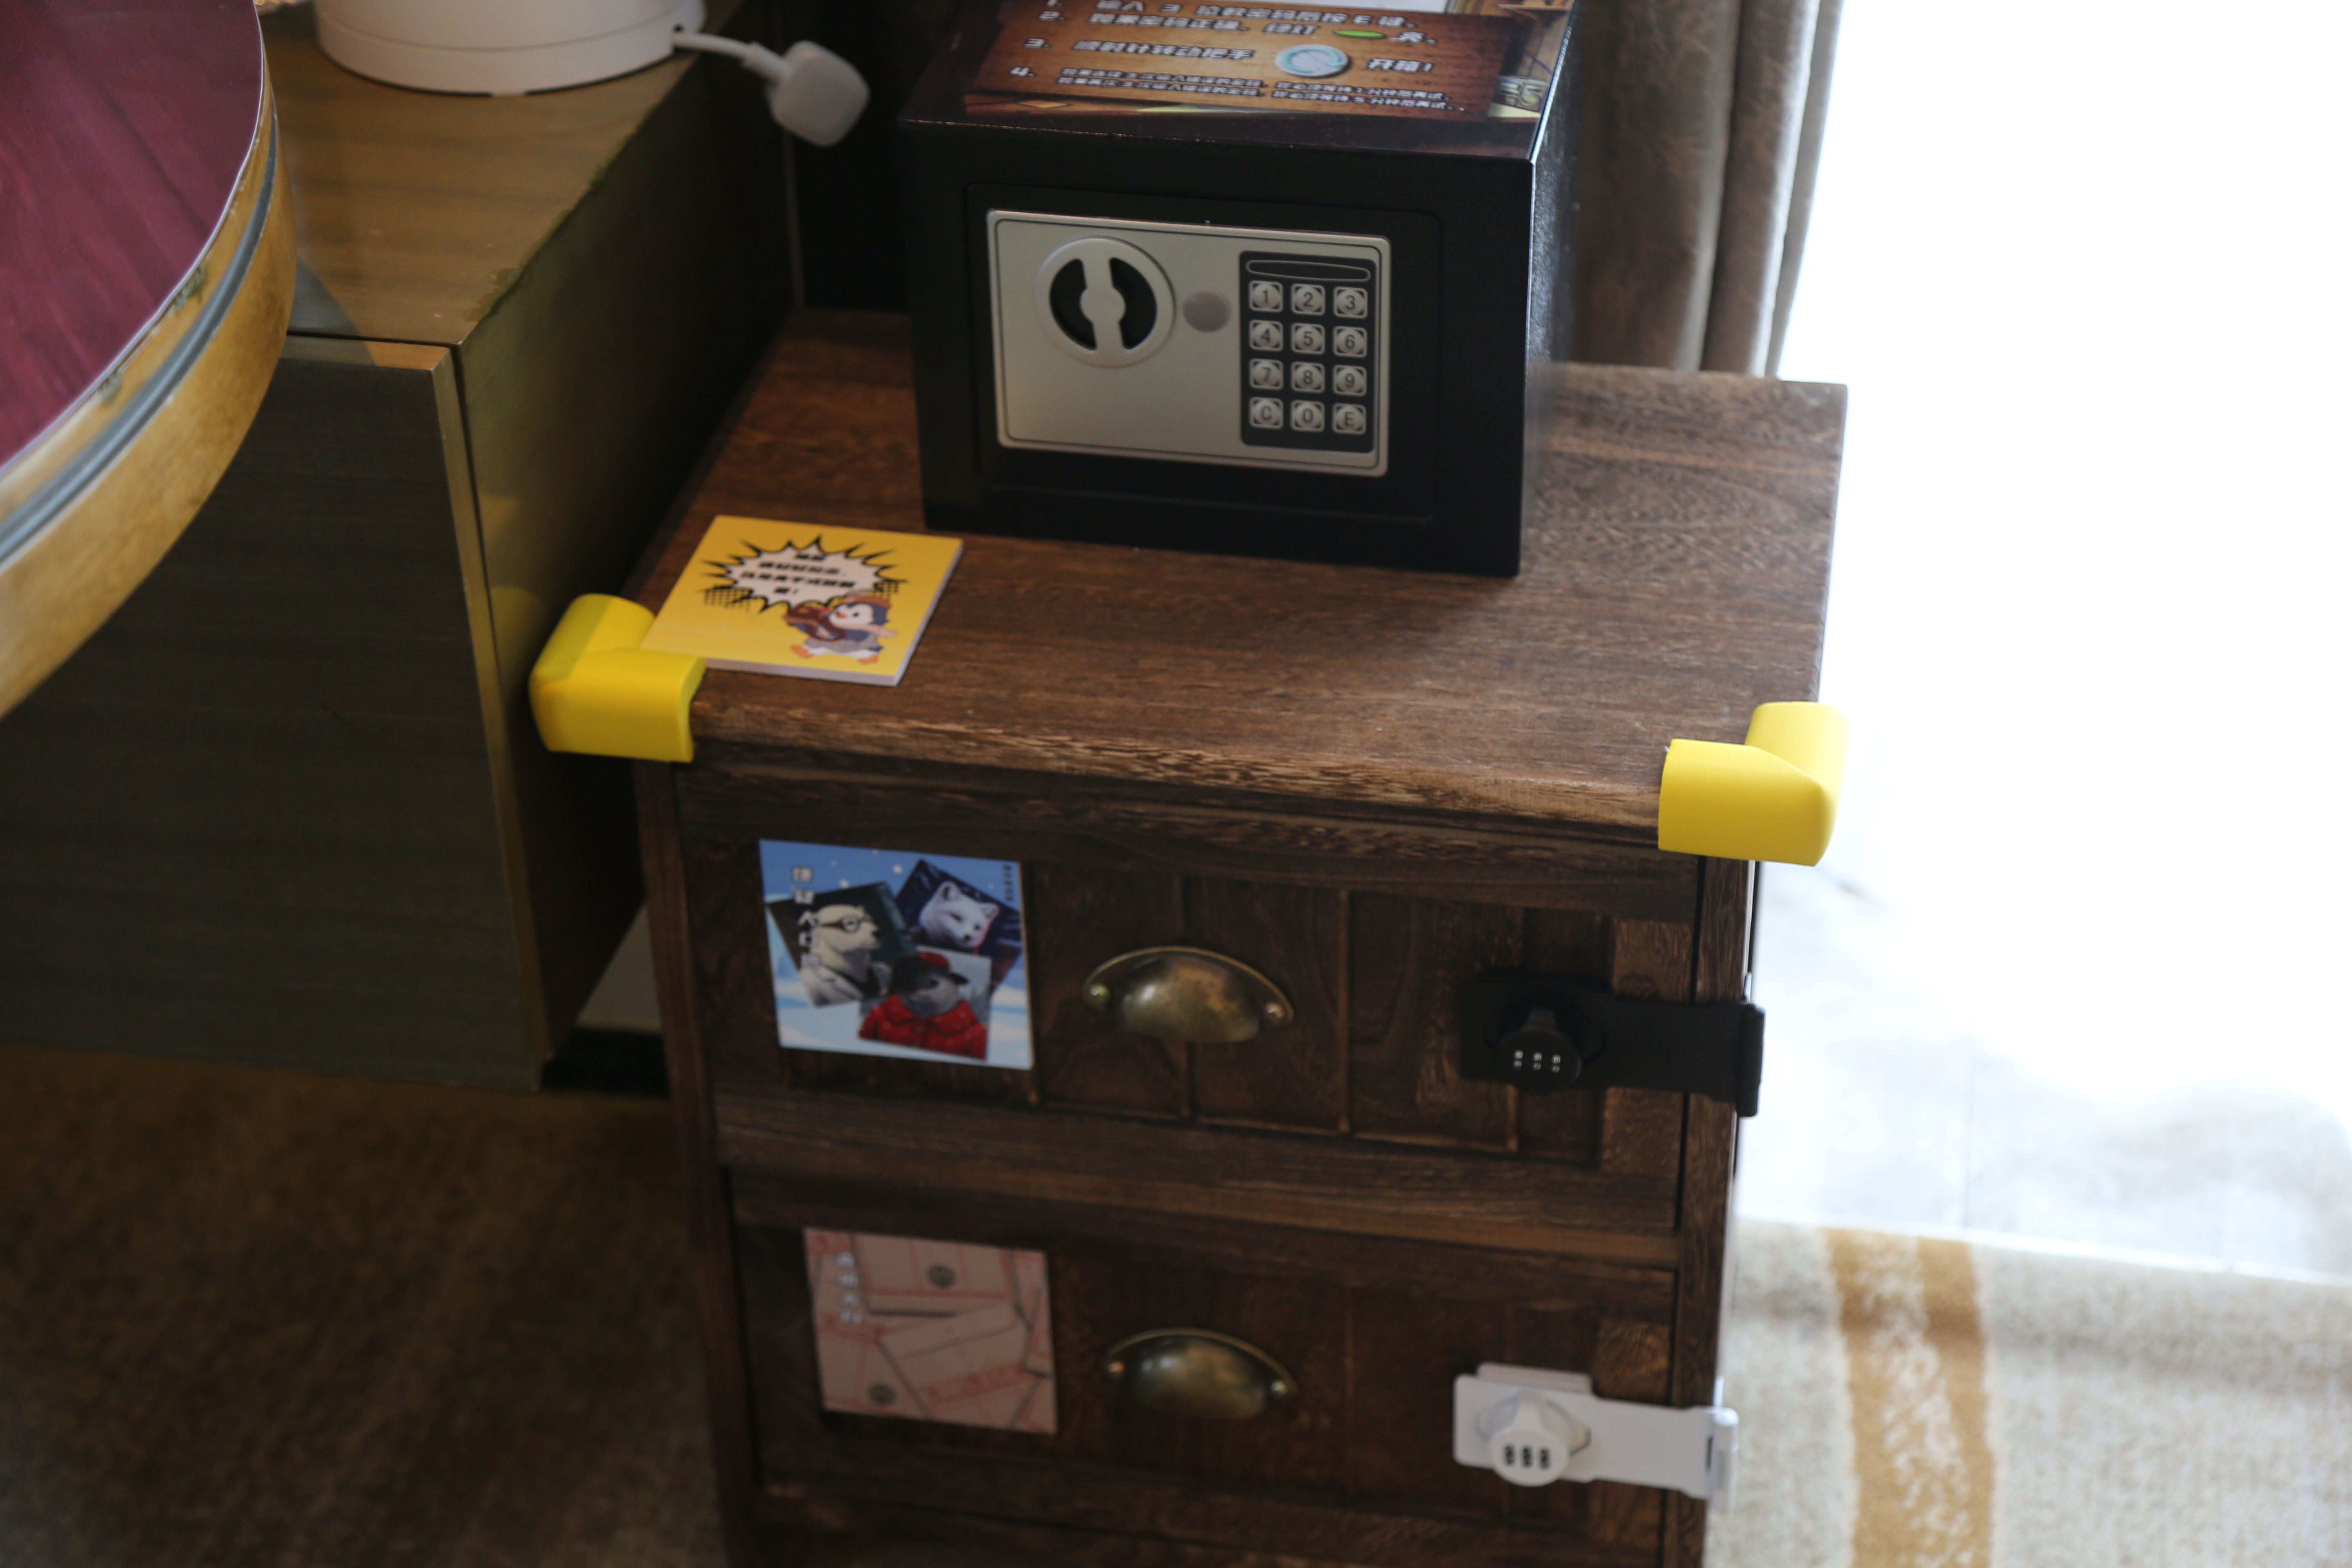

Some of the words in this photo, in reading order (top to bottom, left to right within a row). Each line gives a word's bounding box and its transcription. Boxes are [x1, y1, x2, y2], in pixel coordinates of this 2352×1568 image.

[1159, 3, 1182, 13] 3
[1039, 11, 1065, 21] 2.
[1023, 38, 1050, 49] 3.
[1010, 67, 1035, 78] 4.
[1263, 290, 1268, 304] 1
[1303, 292, 1314, 307] 2
[1346, 295, 1355, 310] 3
[1261, 328, 1270, 343] 4
[1304, 331, 1313, 346] 5
[1346, 334, 1355, 349] 6
[1261, 367, 1271, 381] 7
[1303, 370, 1314, 385] 8
[1346, 373, 1355, 388] 9
[1262, 405, 1272, 420] C
[1303, 409, 1314, 424] 0
[1344, 412, 1355, 426] E
